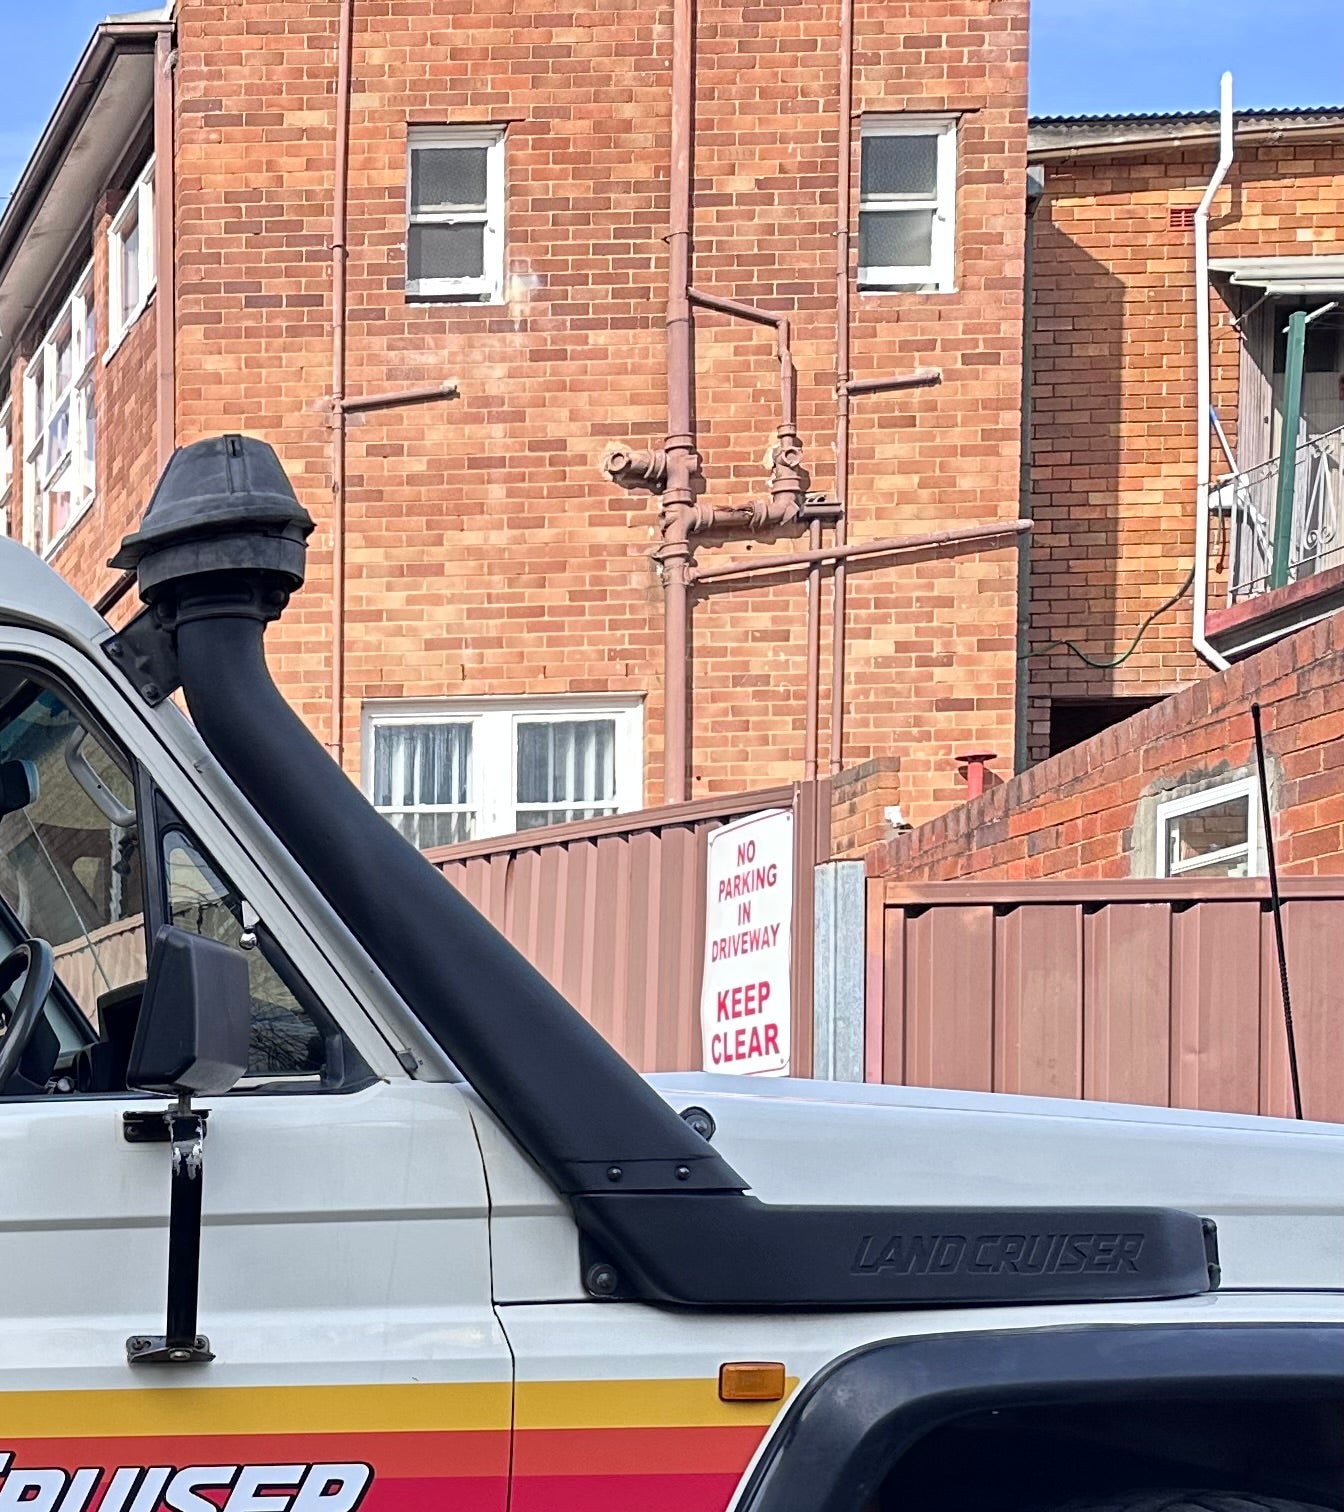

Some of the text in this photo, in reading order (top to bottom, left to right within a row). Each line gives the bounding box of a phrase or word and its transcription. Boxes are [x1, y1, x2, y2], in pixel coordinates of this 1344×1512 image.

[737, 839, 756, 867] NO
[718, 863, 778, 903] PARKING
[737, 900, 752, 926] IN
[711, 922, 780, 963] DRIVEWAY
[716, 980, 771, 1023] KEEP
[711, 1023, 780, 1065] CLEAR
